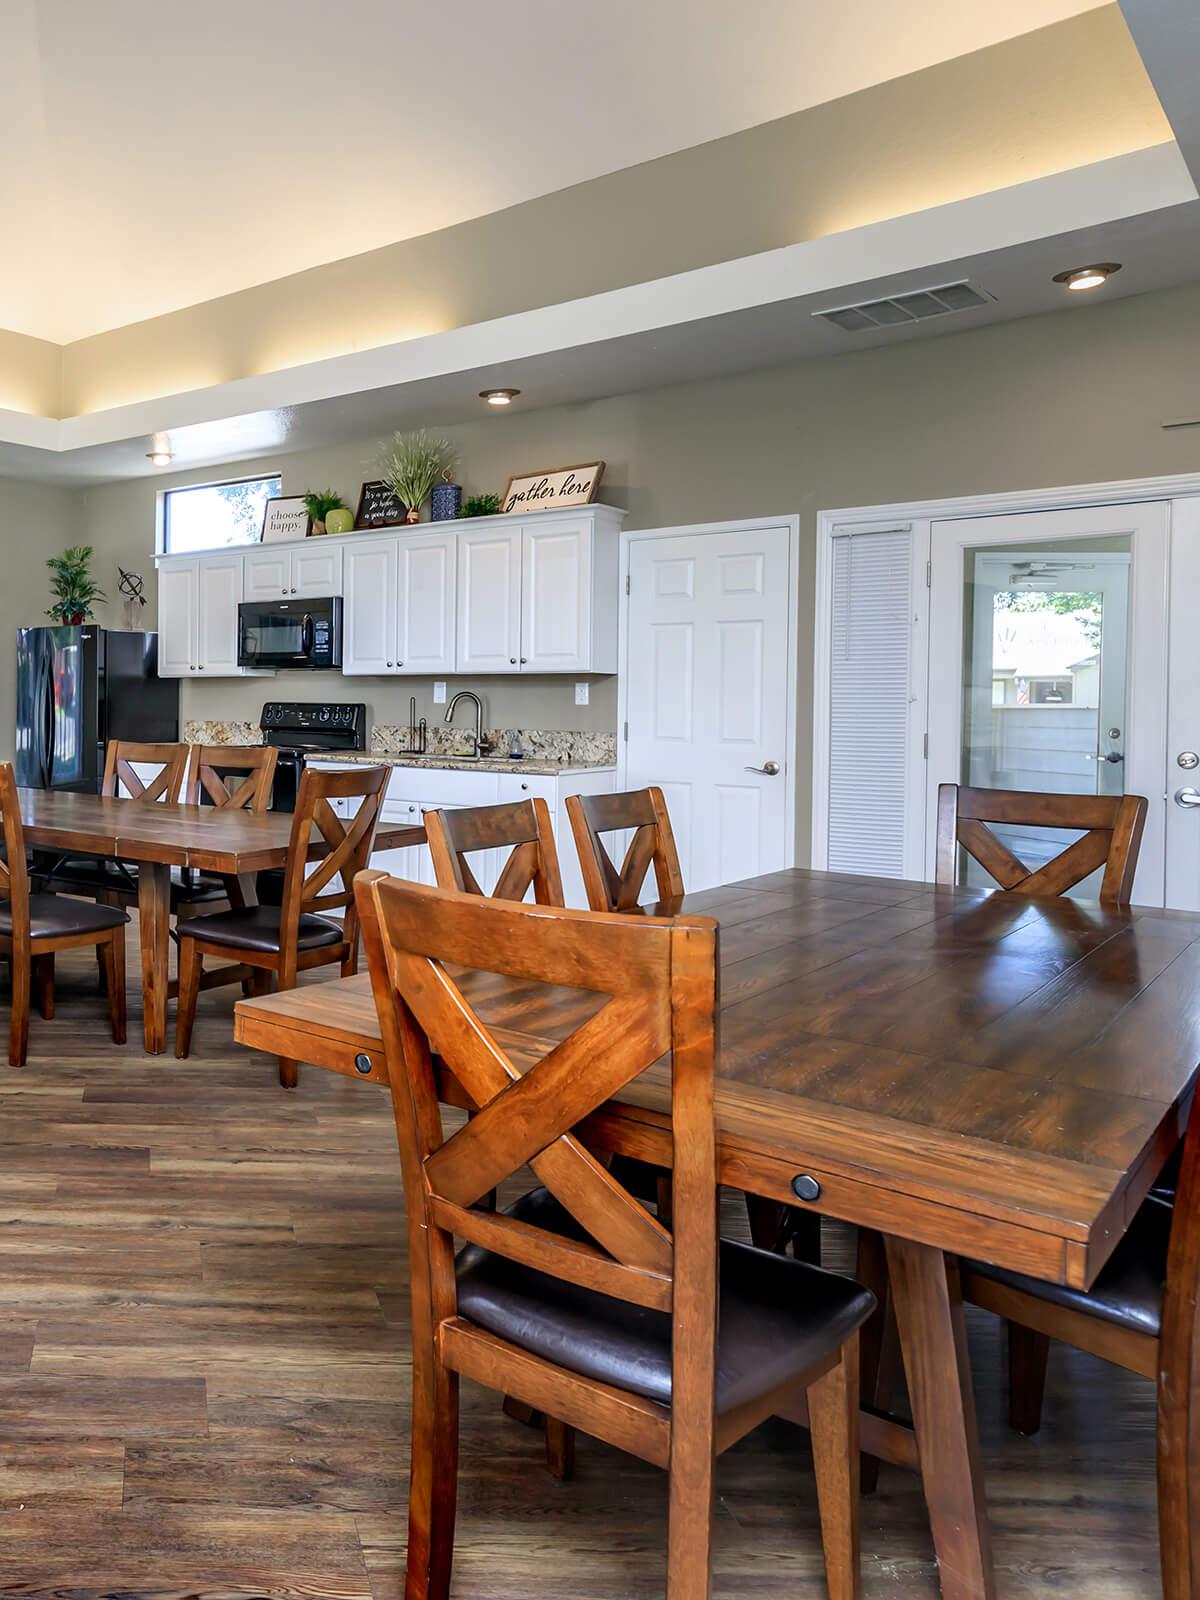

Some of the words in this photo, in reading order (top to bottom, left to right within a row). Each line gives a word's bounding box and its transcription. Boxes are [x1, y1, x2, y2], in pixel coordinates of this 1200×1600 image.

[507, 478, 555, 512] gather
[559, 474, 591, 496] here
[271, 510, 304, 520] choose
[270, 521, 301, 532] happy.
